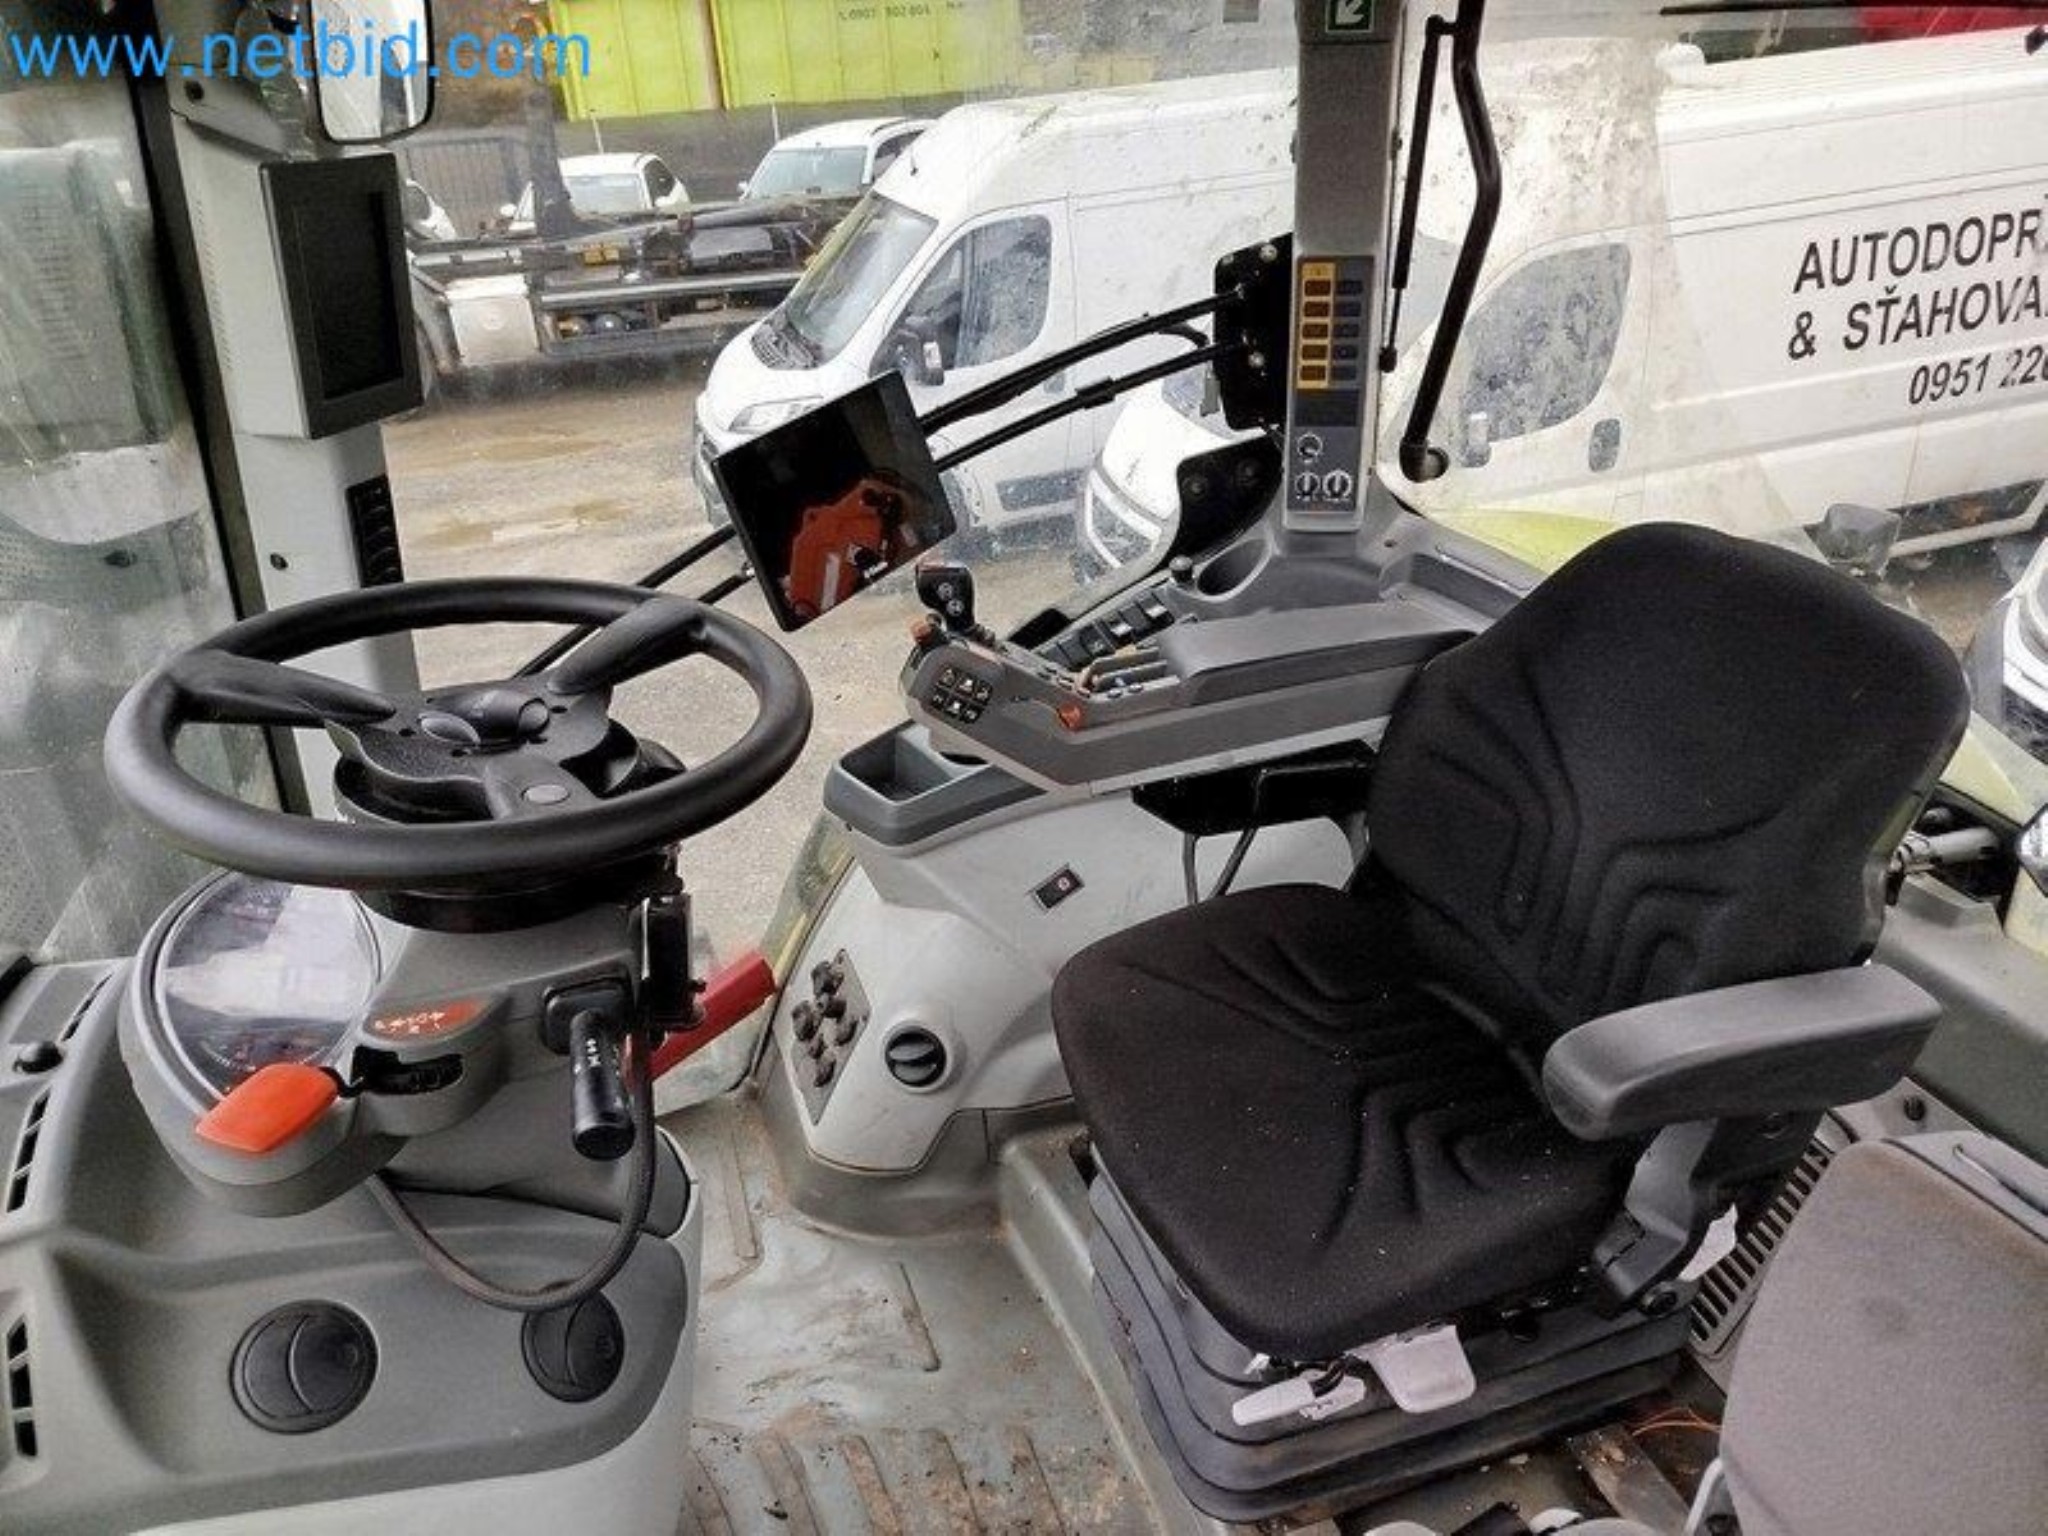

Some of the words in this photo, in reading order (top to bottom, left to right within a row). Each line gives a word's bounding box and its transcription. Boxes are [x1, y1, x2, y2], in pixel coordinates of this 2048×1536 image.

[1793, 205, 2048, 294] AUTODOPR
[1787, 311, 1817, 360] &
[1843, 275, 2048, 351] SŤAHOVA
[1908, 352, 1991, 404] 0951
